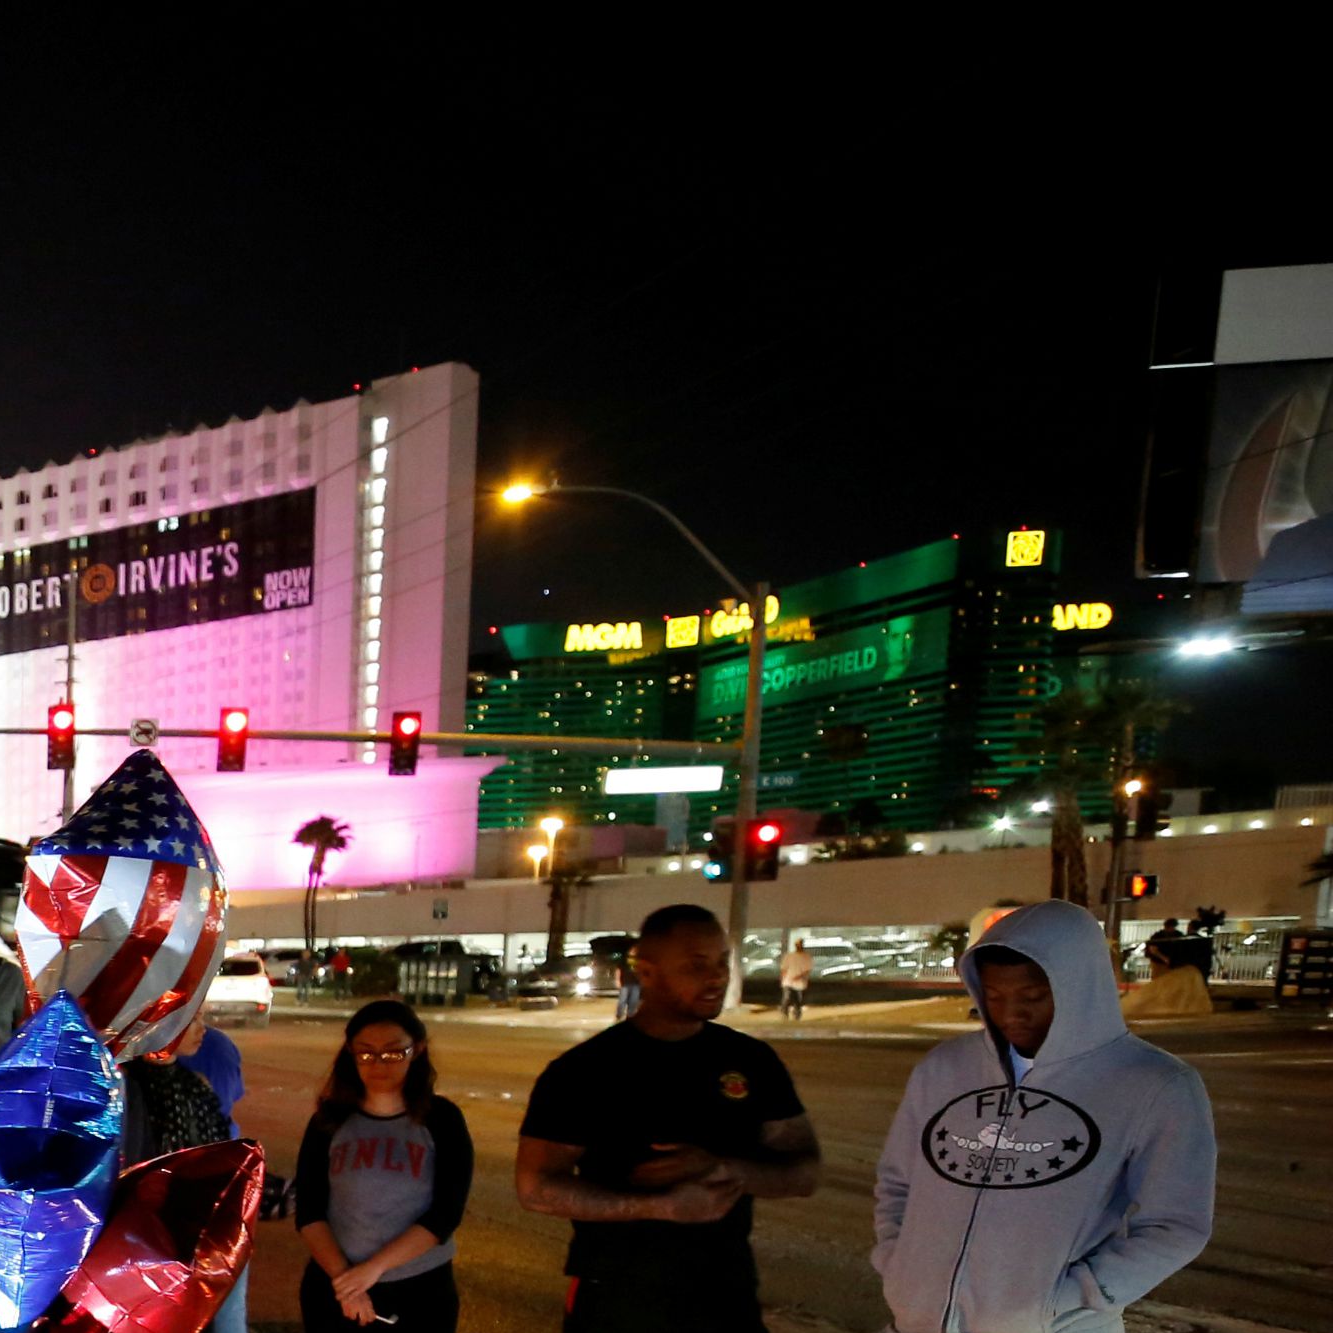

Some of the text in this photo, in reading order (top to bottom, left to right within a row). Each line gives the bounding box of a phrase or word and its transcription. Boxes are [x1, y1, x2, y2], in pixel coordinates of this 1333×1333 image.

[118, 542, 239, 596] IRVINE'S
[265, 567, 311, 591] NOW
[264, 586, 310, 609] OPEN
[564, 622, 643, 652] MGM
[976, 1091, 1050, 1119] FLY
[330, 1136, 426, 1179] UNLV
